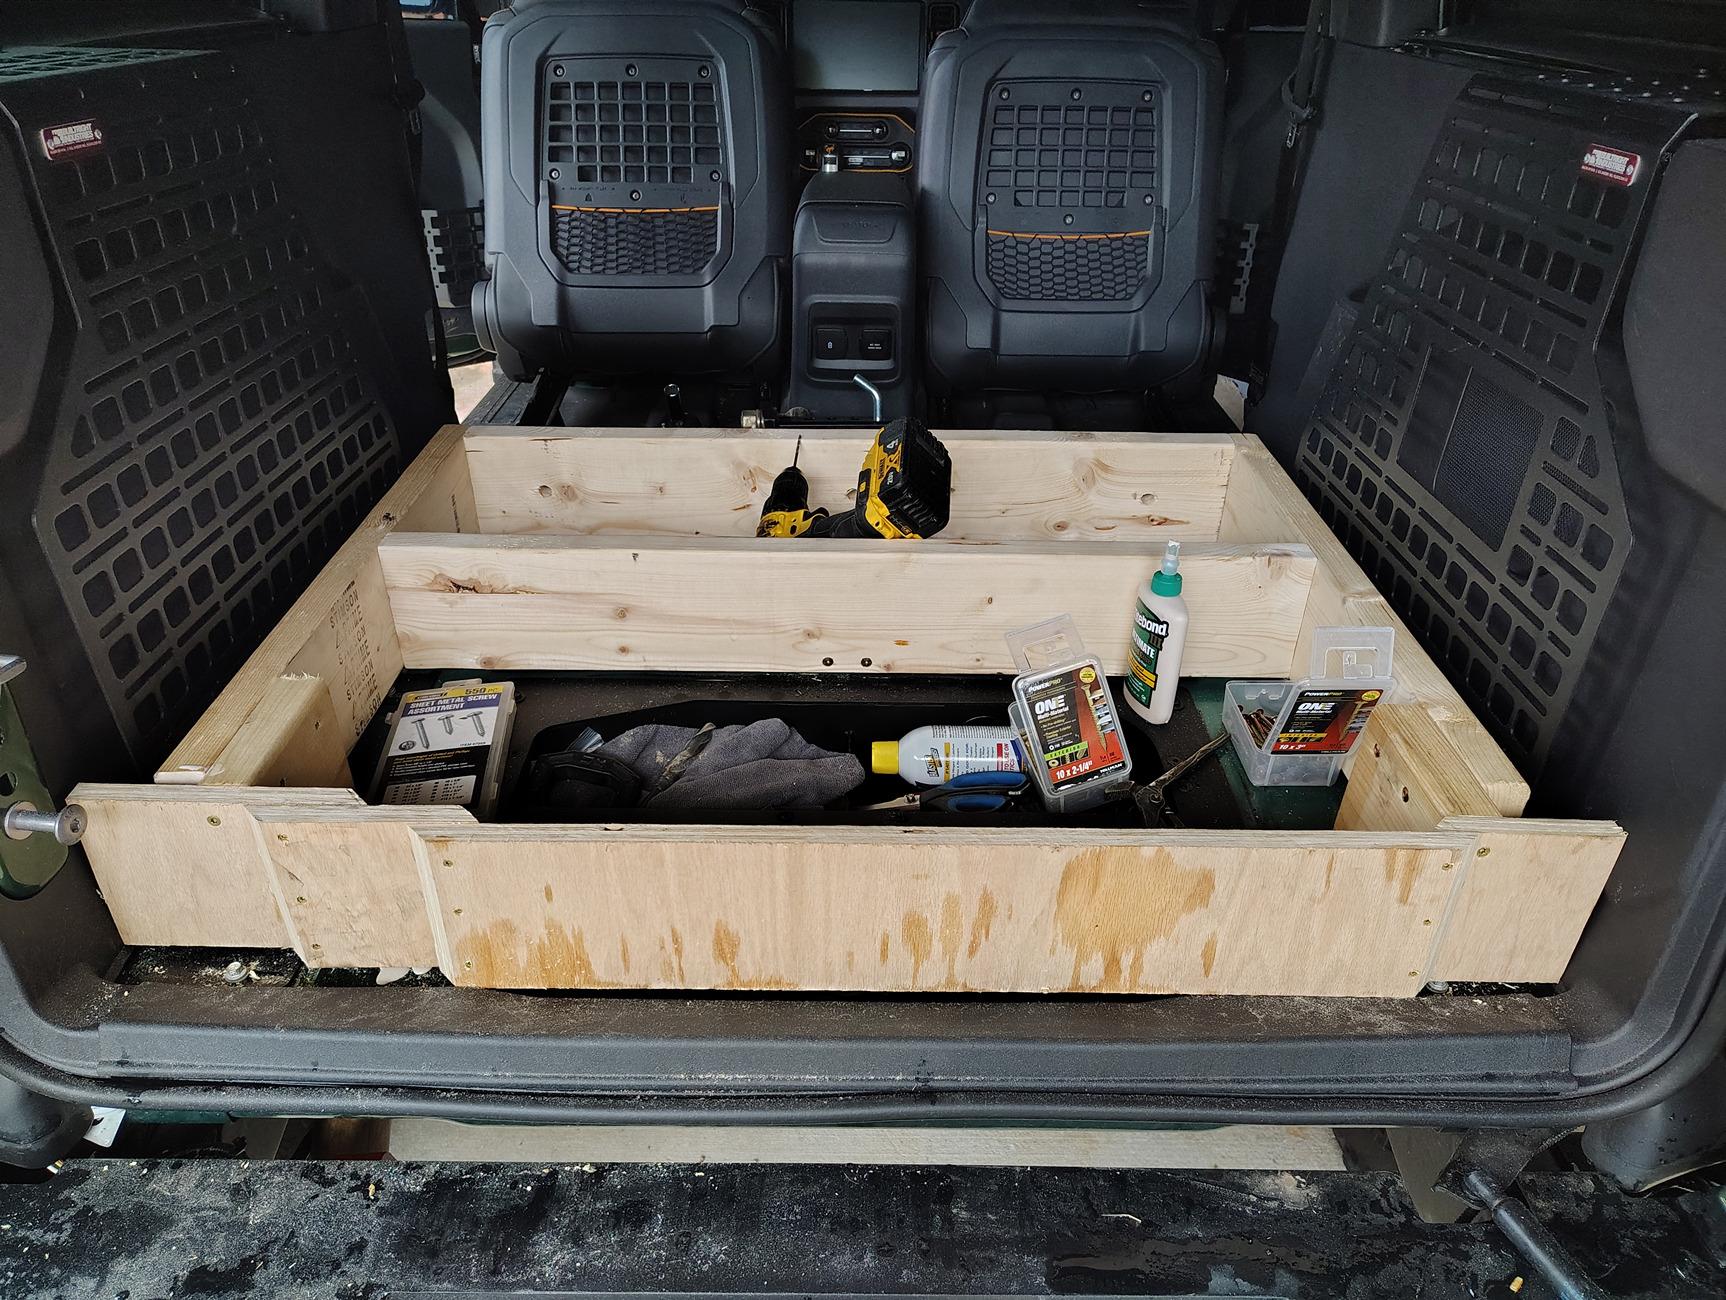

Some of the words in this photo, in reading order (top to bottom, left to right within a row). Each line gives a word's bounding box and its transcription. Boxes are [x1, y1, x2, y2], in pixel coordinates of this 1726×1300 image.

[410, 700, 435, 709] SHEET
[437, 697, 464, 706] METAL
[467, 694, 498, 702] SCREW
[1034, 694, 1066, 715] ONE
[1298, 702, 1335, 711] ONE
[407, 703, 465, 715] ASSORTMENT
[1056, 769, 1065, 780] 10
[1066, 768, 1071, 777] x
